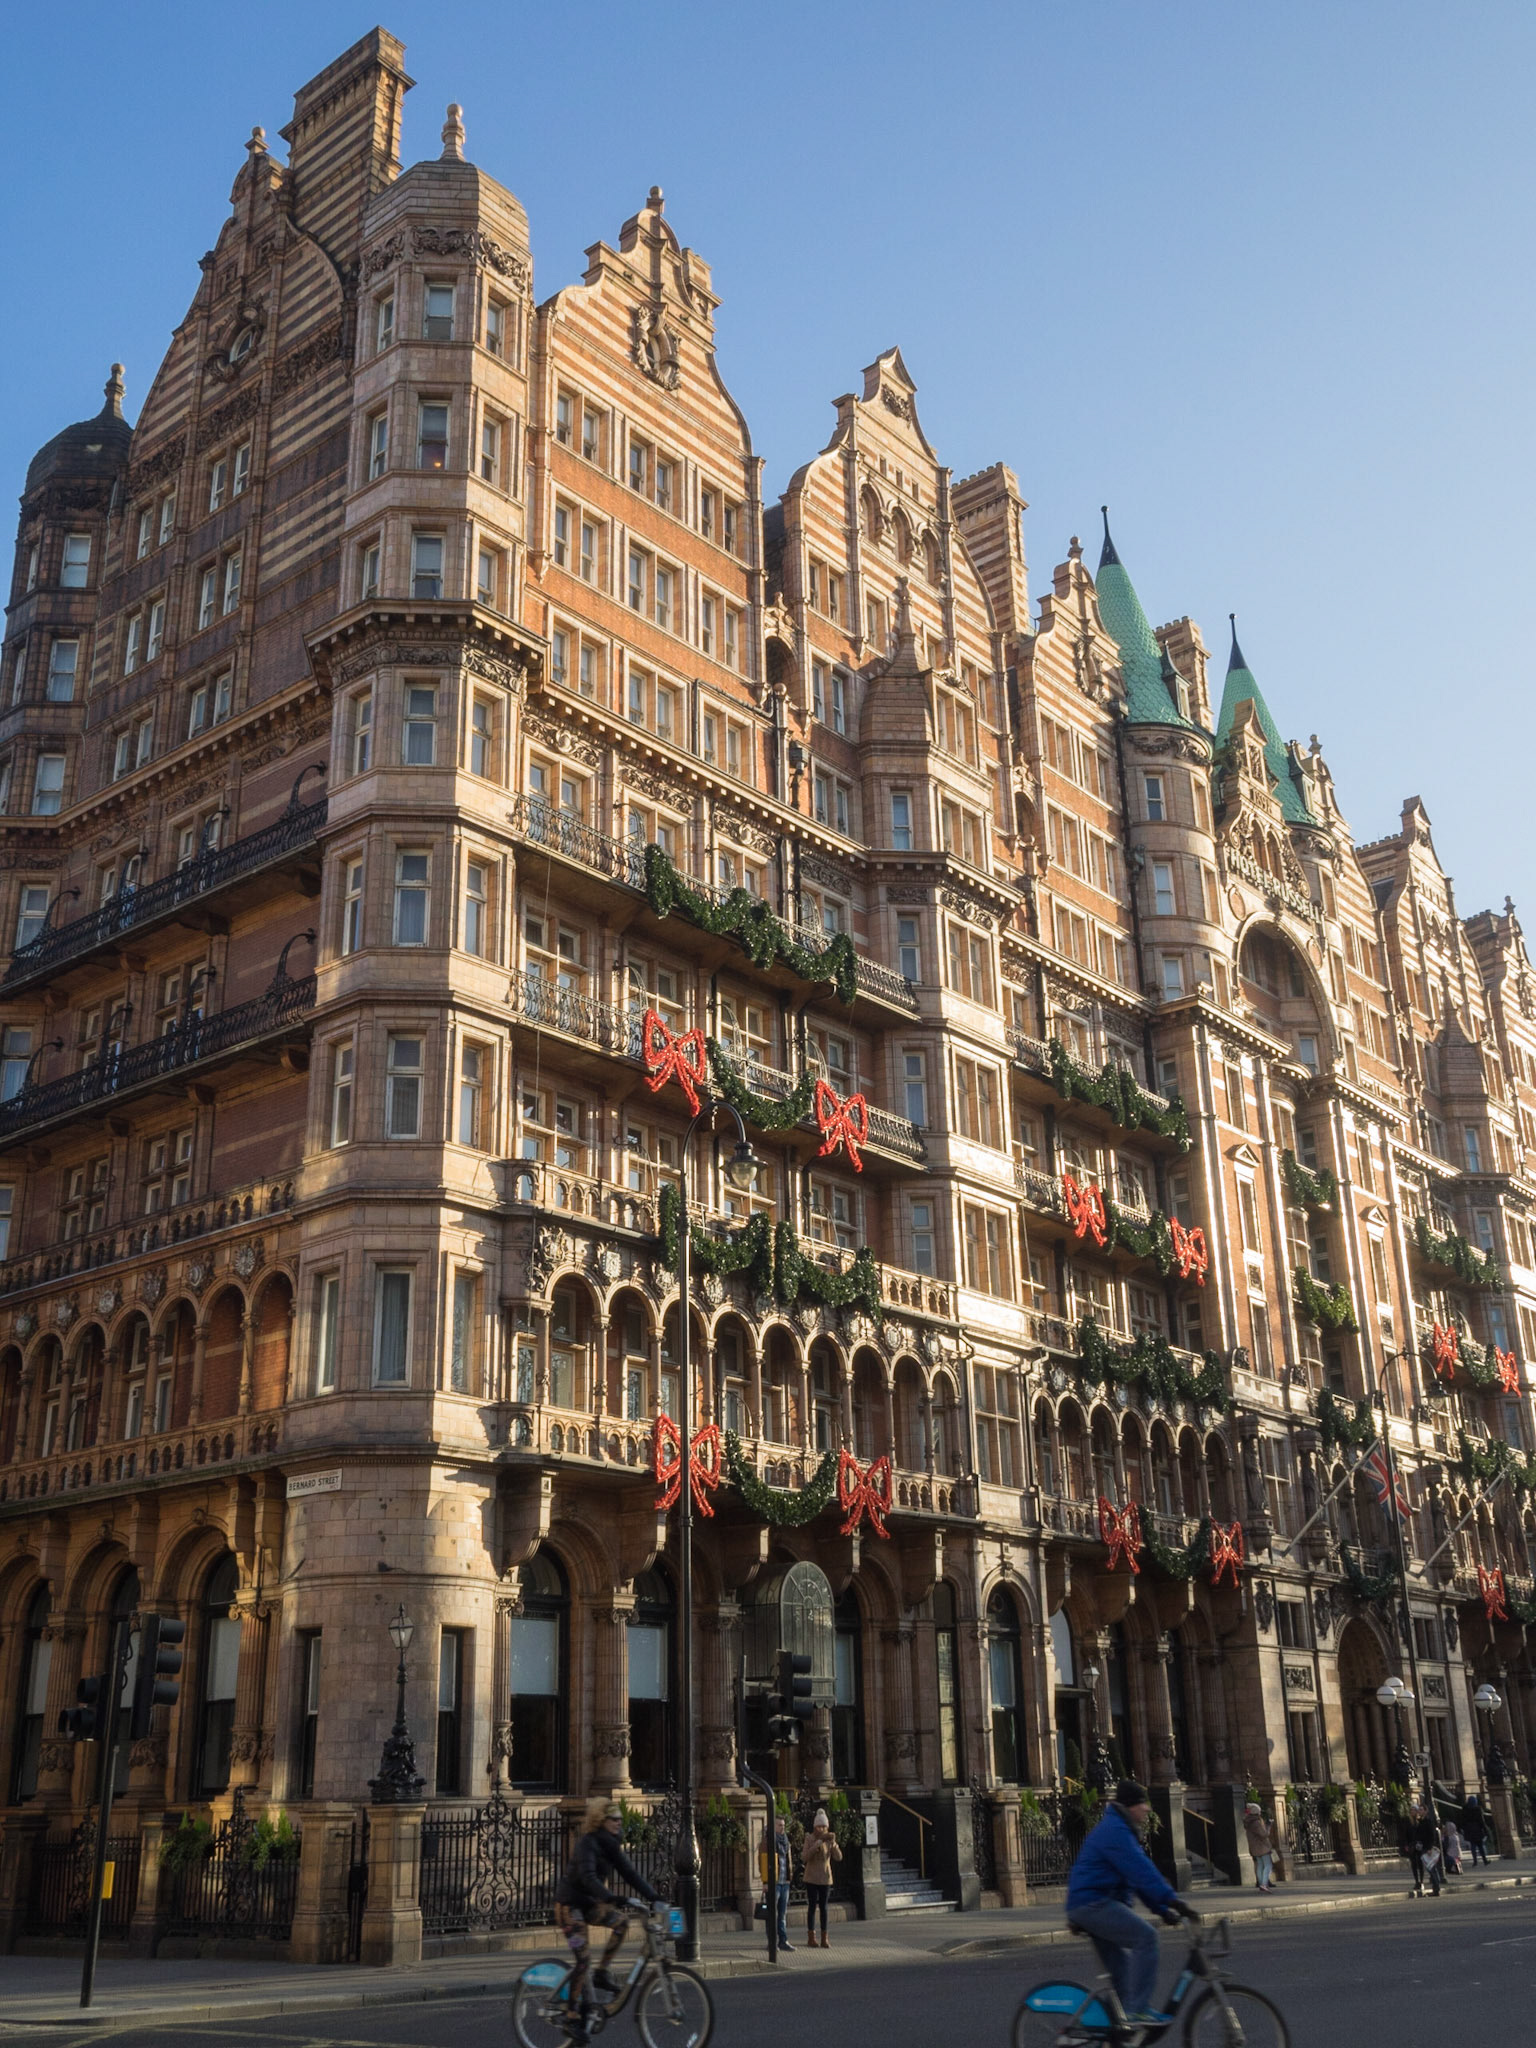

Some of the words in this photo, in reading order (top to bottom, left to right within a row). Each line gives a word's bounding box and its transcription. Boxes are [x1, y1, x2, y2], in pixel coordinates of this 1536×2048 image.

[1231, 847, 1272, 889] HOTEL
[1273, 877, 1320, 924] RUSSELL
[289, 1479, 316, 1491] BERNARD
[318, 1476, 340, 1486] STREET
